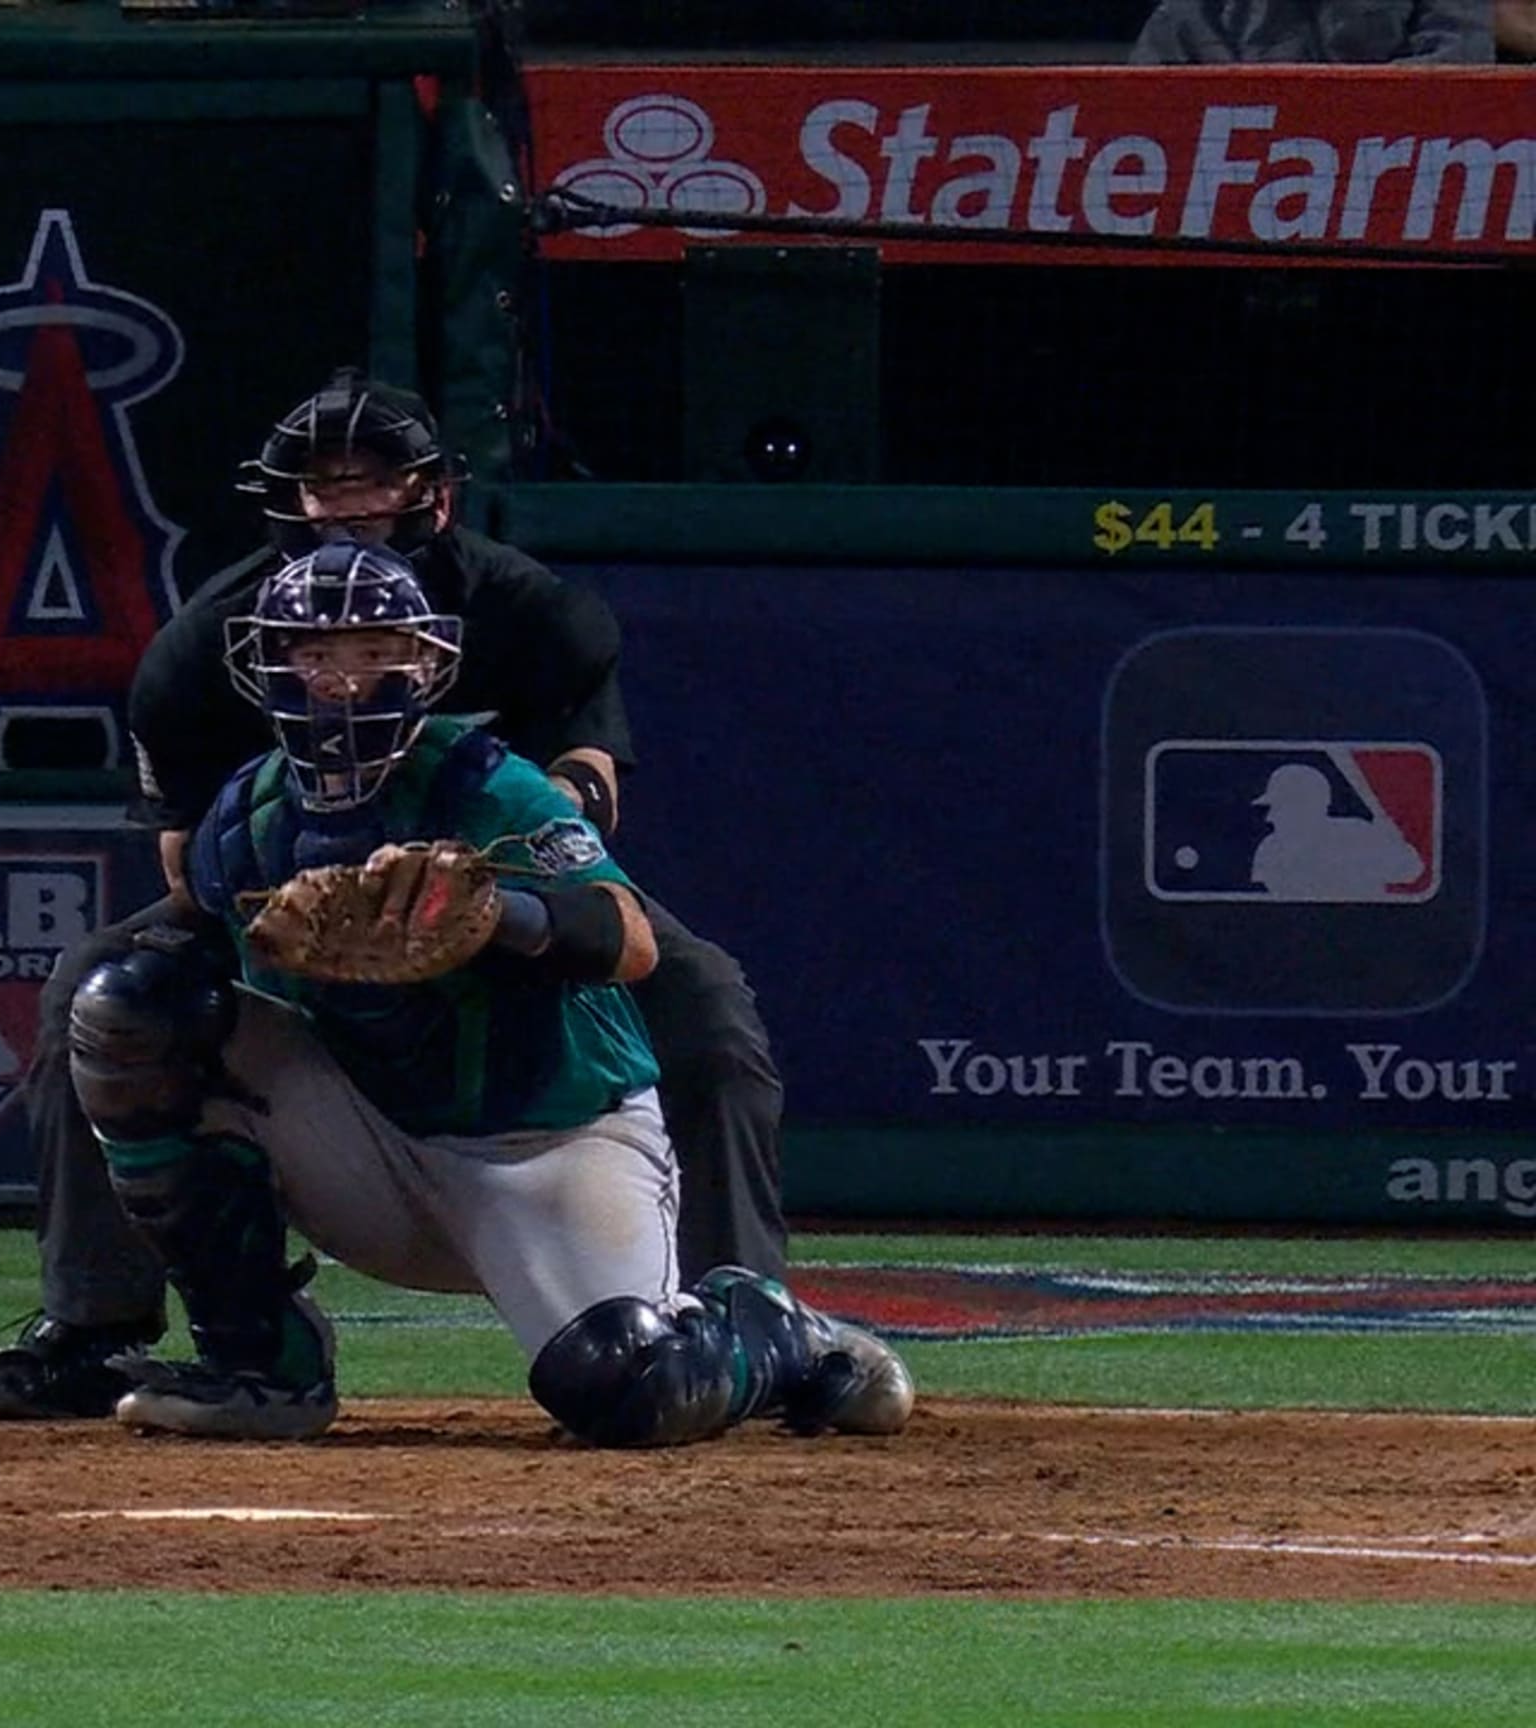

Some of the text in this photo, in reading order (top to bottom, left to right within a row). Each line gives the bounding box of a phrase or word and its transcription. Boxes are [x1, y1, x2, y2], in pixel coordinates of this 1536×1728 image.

[1093, 501, 1219, 555] $44
[1285, 503, 1327, 550] 4
[1350, 503, 1536, 551] TICK
[919, 1040, 1517, 1100] Your Team. Your
